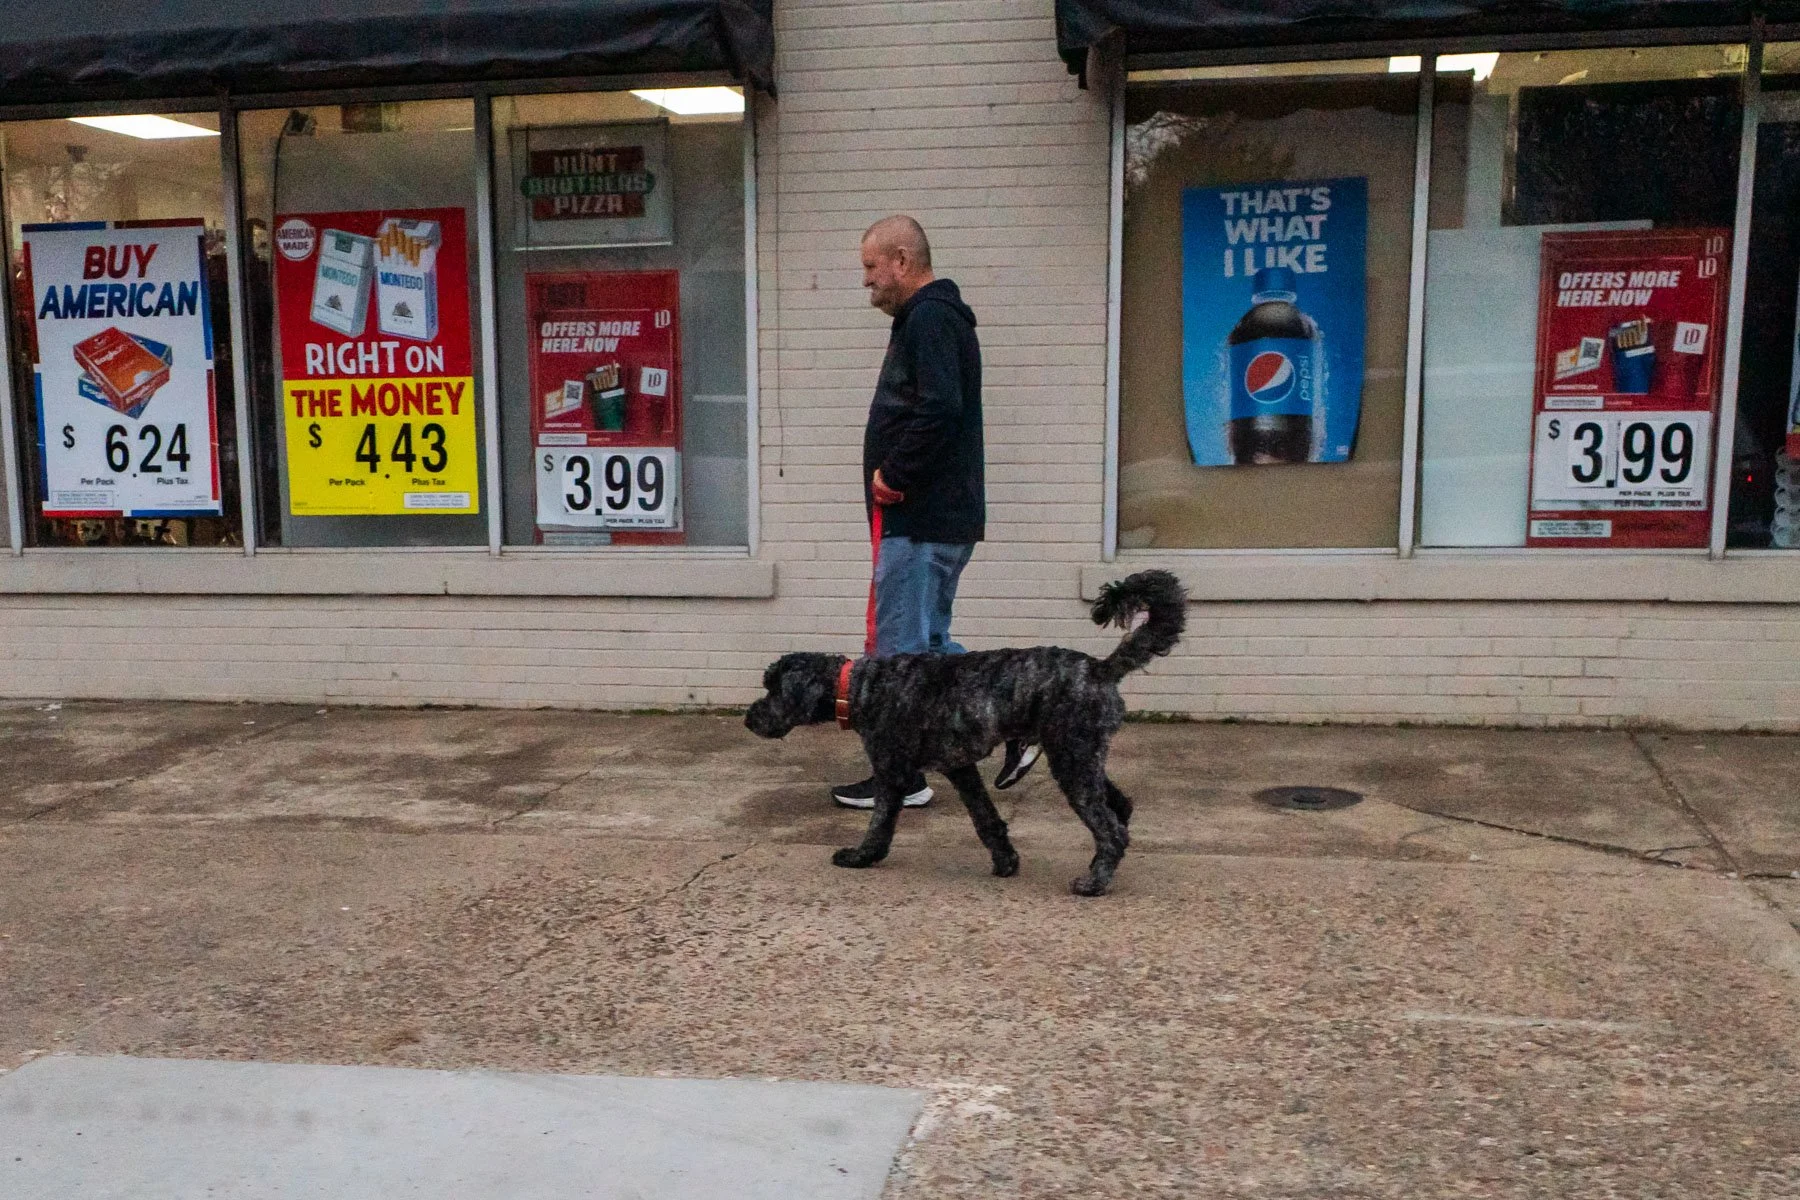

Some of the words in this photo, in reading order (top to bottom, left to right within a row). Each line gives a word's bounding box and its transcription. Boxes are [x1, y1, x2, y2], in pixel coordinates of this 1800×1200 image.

[554, 194, 622, 215] PIZZA
[1220, 187, 1331, 215] THAT'S
[276, 227, 316, 240] AMERICAN
[1224, 214, 1328, 245] WHAT
[283, 240, 310, 251] MADE
[83, 244, 158, 279] BUY
[321, 265, 358, 286] MONTEGO
[1224, 248, 1234, 278] I
[1244, 244, 1328, 276] LIKE
[380, 271, 423, 291] MONTEGO
[1559, 272, 1626, 289] OFFERS
[1628, 271, 1680, 288] MORE
[39, 282, 198, 319] AMERICAN
[541, 321, 597, 337] OFFERS
[598, 321, 641, 336] MORE
[305, 341, 400, 375] RIGHT
[404, 346, 445, 372] ON
[290, 389, 342, 418] THE
[351, 382, 465, 417] MONEY
[62, 423, 76, 450] $
[105, 423, 191, 478] 6.24
[308, 422, 323, 449] $
[355, 423, 448, 479] 4.43
[1548, 419, 1561, 440] $
[1571, 421, 1694, 488] 3.99
[157, 477, 173, 485] Plus
[176, 477, 189, 485] Tax
[329, 478, 342, 486] Per
[345, 478, 365, 486] Pack
[412, 478, 429, 486] Plus
[432, 478, 445, 486] Tax
[543, 454, 554, 473] $
[565, 455, 664, 516] 3.99
